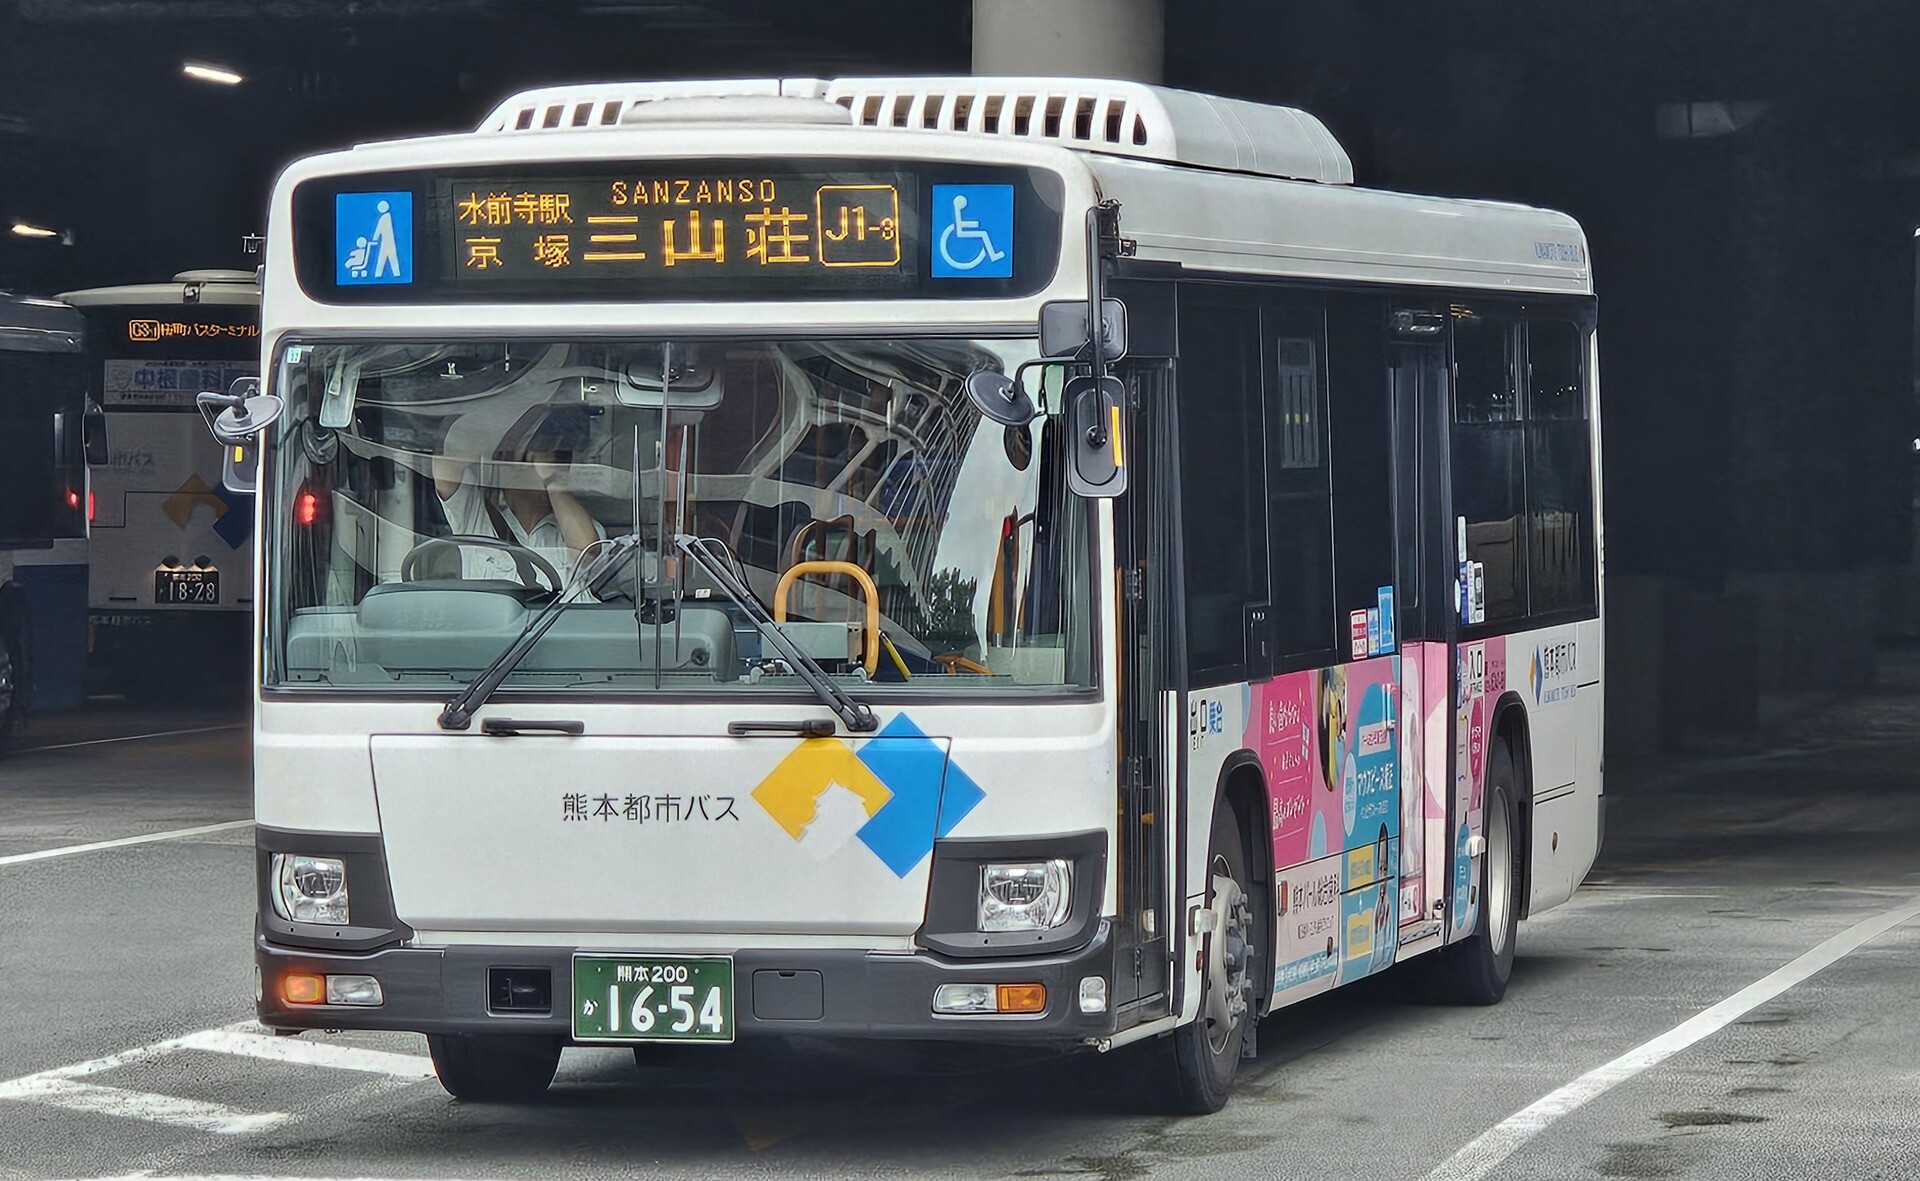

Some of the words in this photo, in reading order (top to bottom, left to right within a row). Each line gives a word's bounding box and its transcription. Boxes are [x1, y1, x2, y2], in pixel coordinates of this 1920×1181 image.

[458, 191, 574, 225] 水前寺駅
[612, 179, 775, 205] SANZANSO
[583, 206, 810, 266] 三山荘
[562, 793, 739, 824] 熊本都市バス
[583, 999, 599, 1016] か
[609, 984, 724, 1034] 16-54
